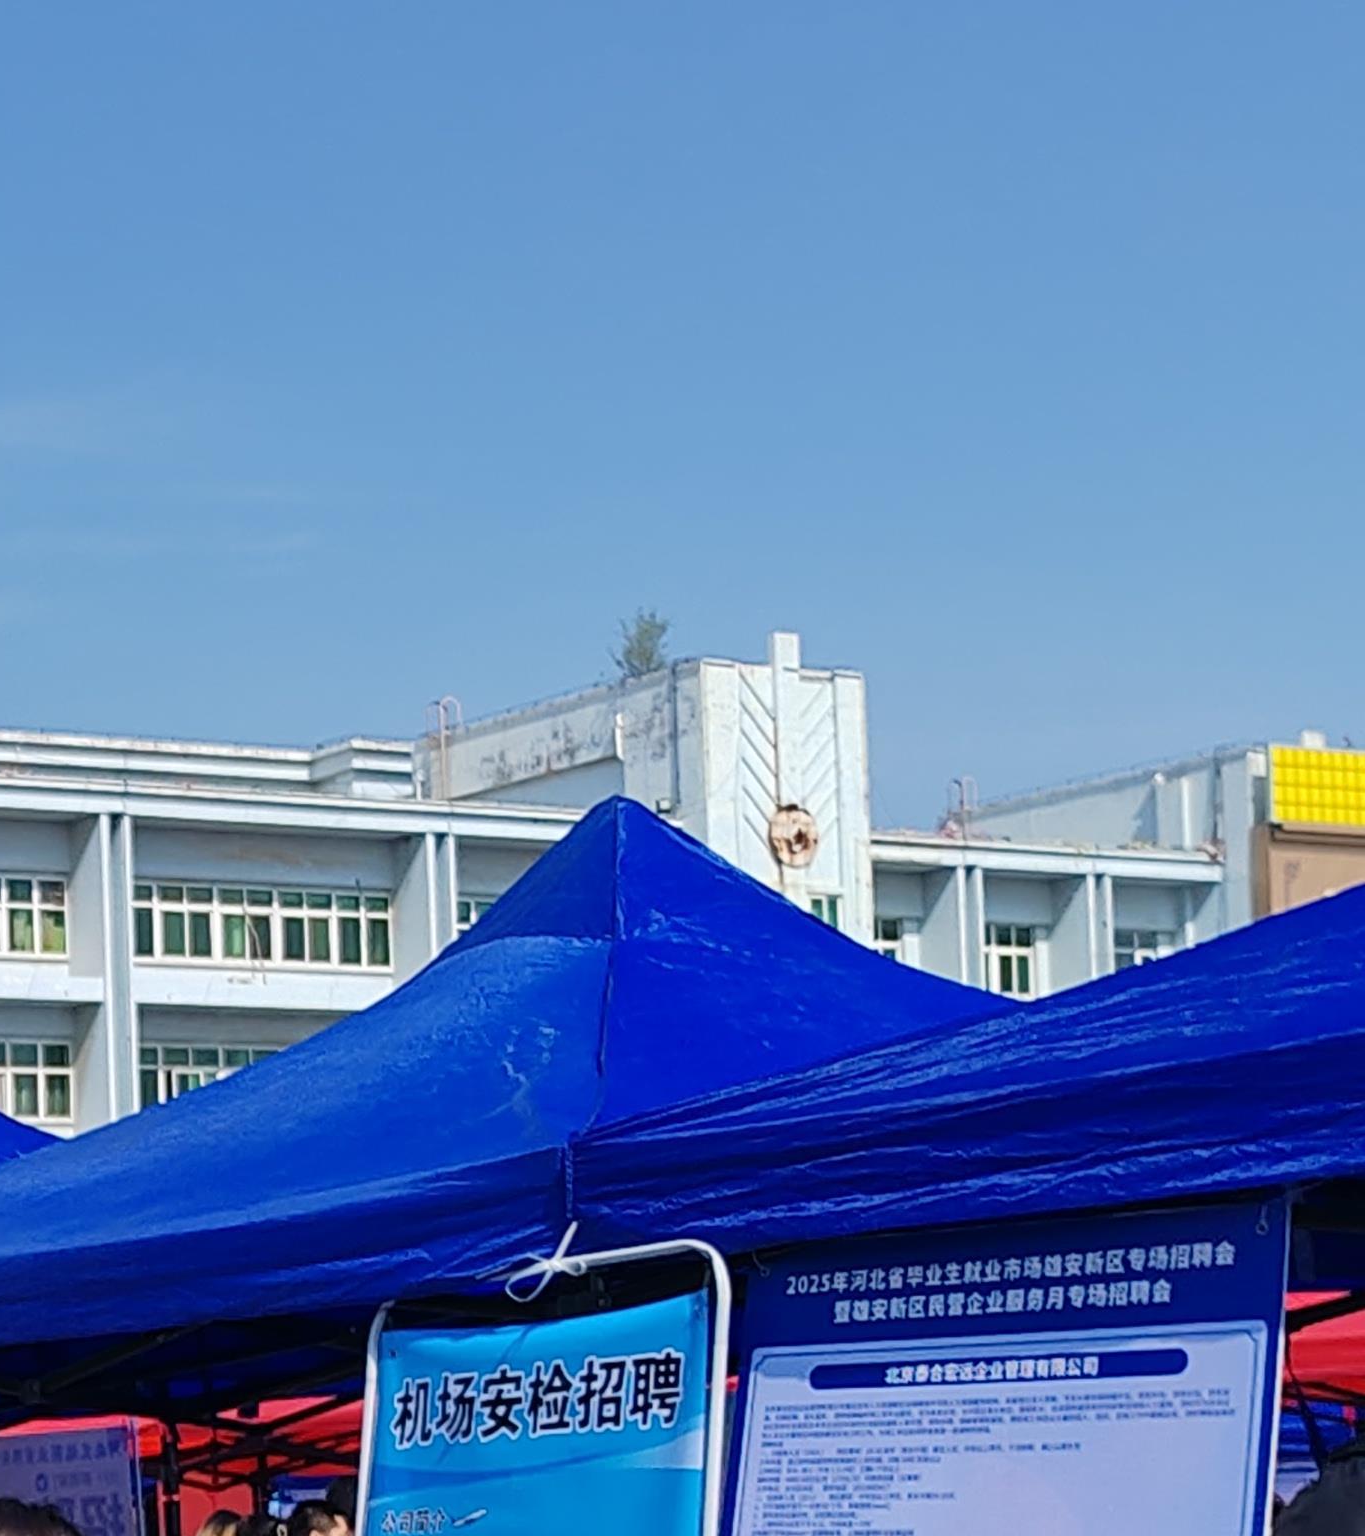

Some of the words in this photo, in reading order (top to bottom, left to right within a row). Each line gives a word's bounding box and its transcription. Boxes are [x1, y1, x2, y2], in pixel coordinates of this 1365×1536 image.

[393, 1348, 685, 1450] 机场安检招聘
[381, 1508, 447, 1535] 公司简介
